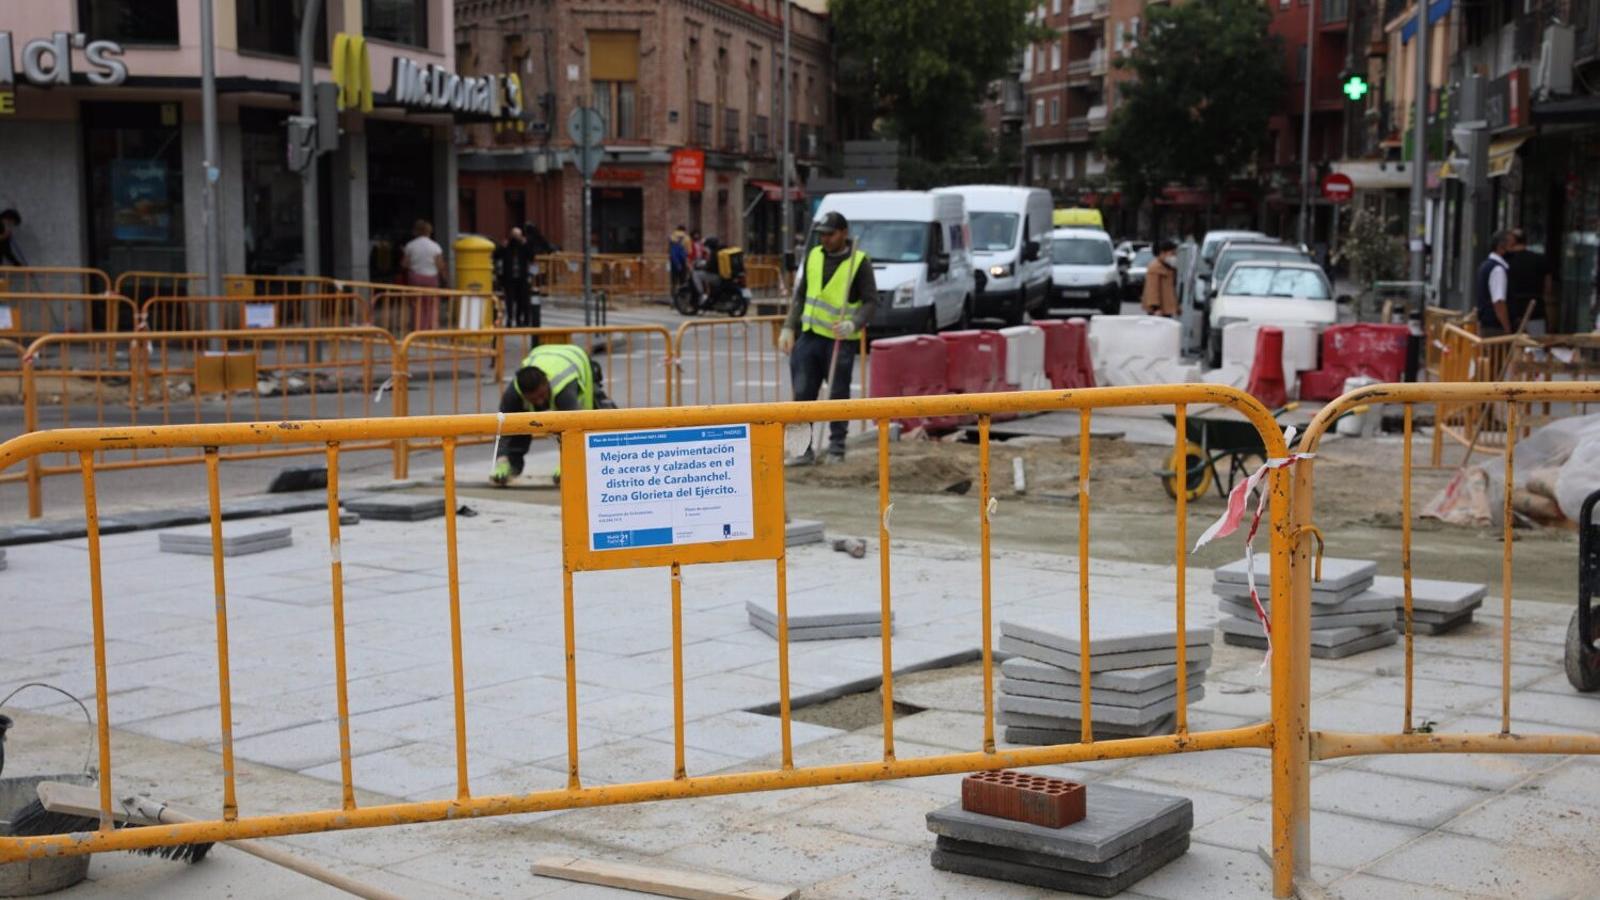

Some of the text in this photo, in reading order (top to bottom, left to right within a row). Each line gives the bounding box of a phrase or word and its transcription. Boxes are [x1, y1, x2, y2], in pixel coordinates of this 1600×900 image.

[600, 444, 735, 463] Mejora de pavimentación
[601, 457, 735, 475] de aceras y calzadas en el
[606, 471, 731, 489] distrito de Carabanchel.
[601, 485, 737, 503] Zona Glorieta del Ejército.
